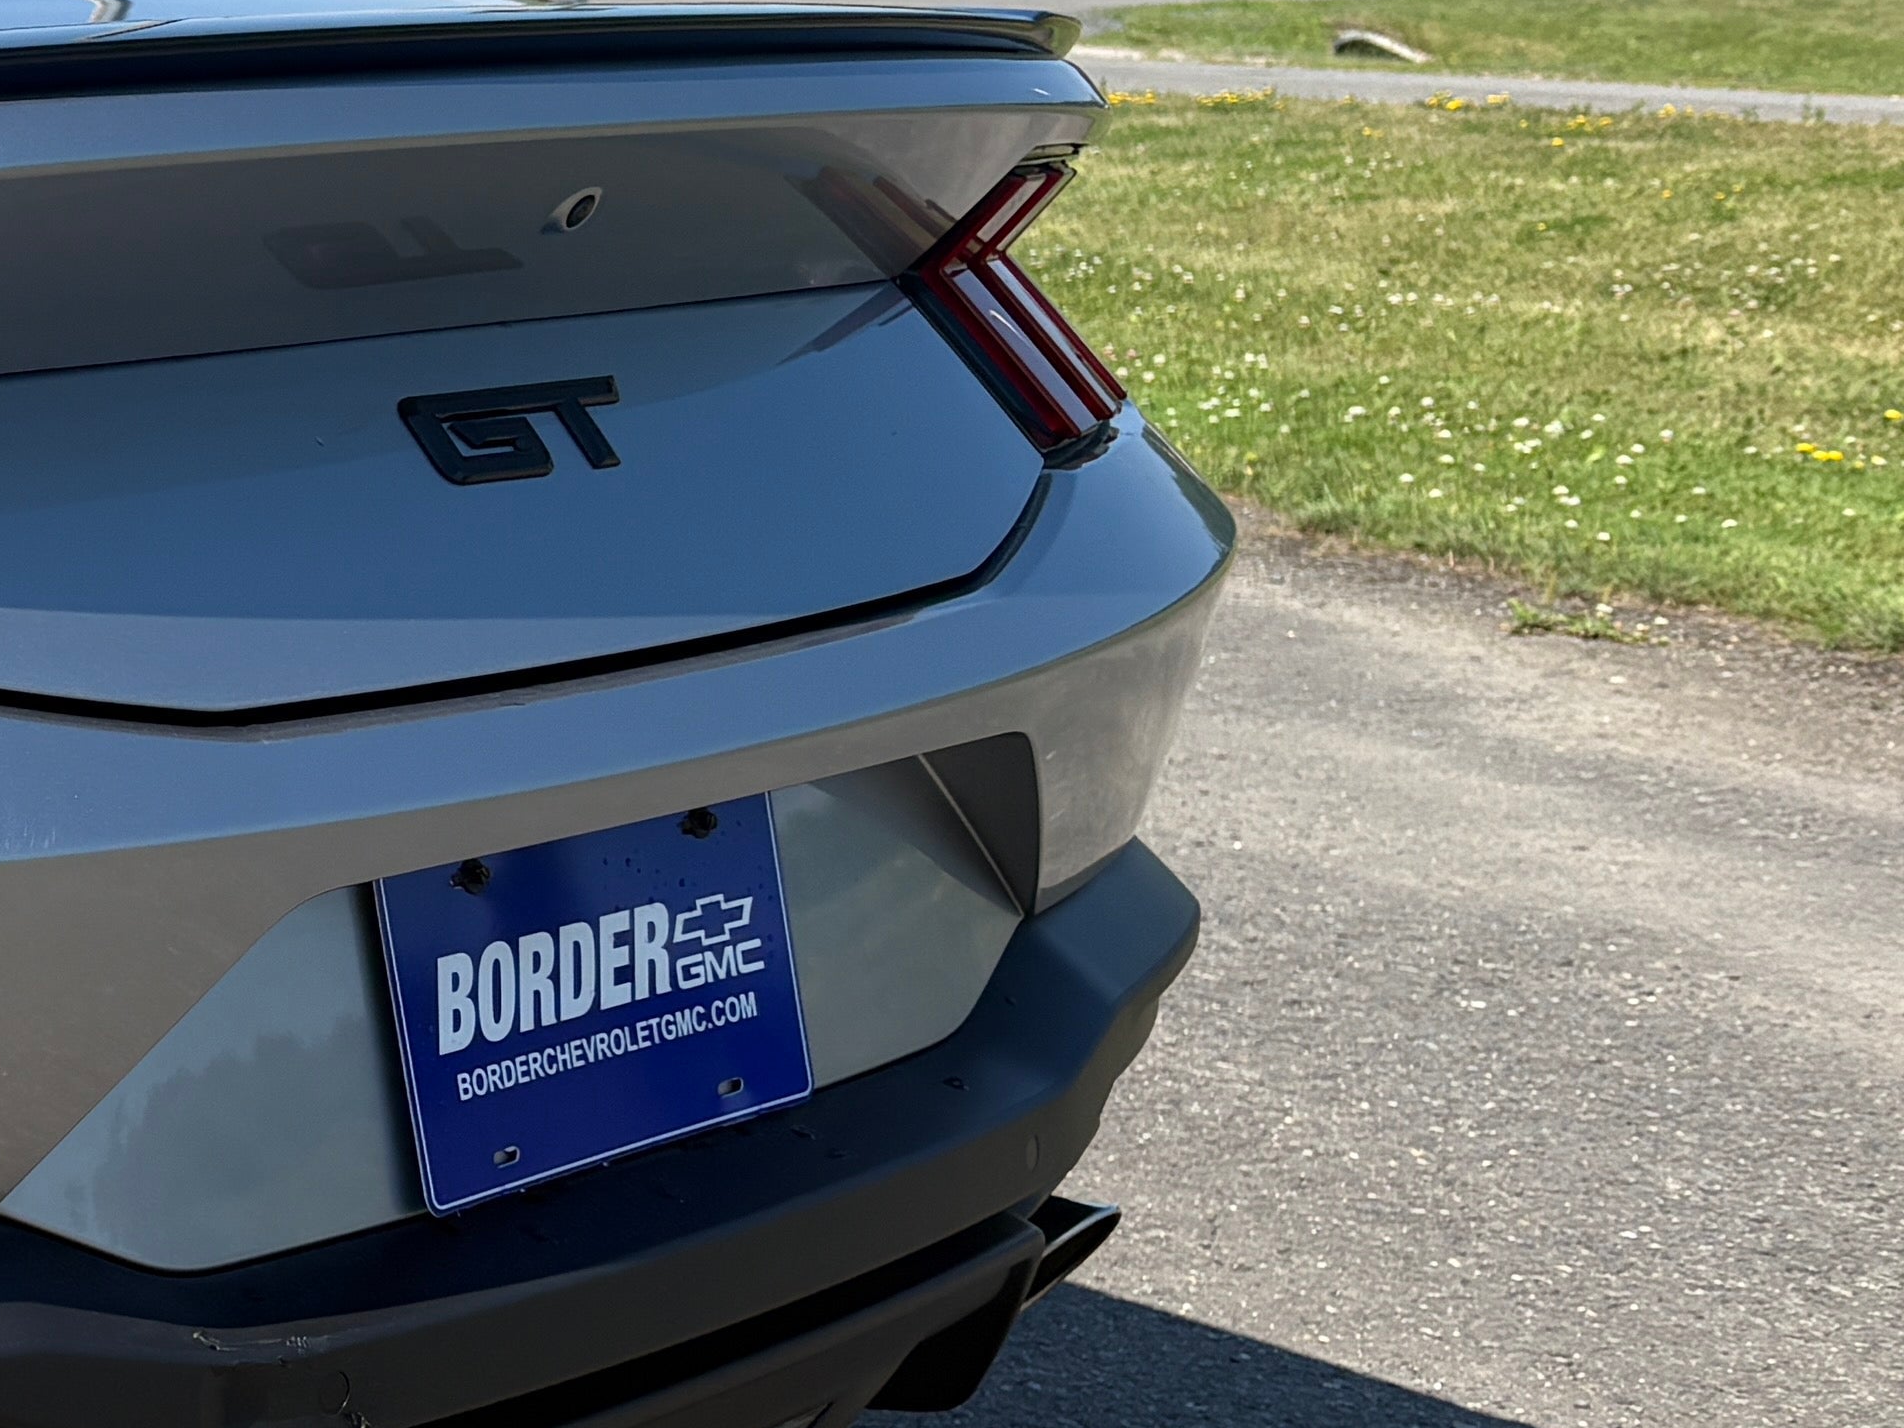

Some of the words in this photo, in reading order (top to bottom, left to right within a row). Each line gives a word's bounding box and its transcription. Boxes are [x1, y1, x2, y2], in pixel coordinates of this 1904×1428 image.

[396, 375, 620, 485] GT
[437, 902, 672, 1055] BORDER
[676, 938, 765, 990] GMC
[457, 991, 758, 1101] BORDERCHEVROLETGMC.COM
